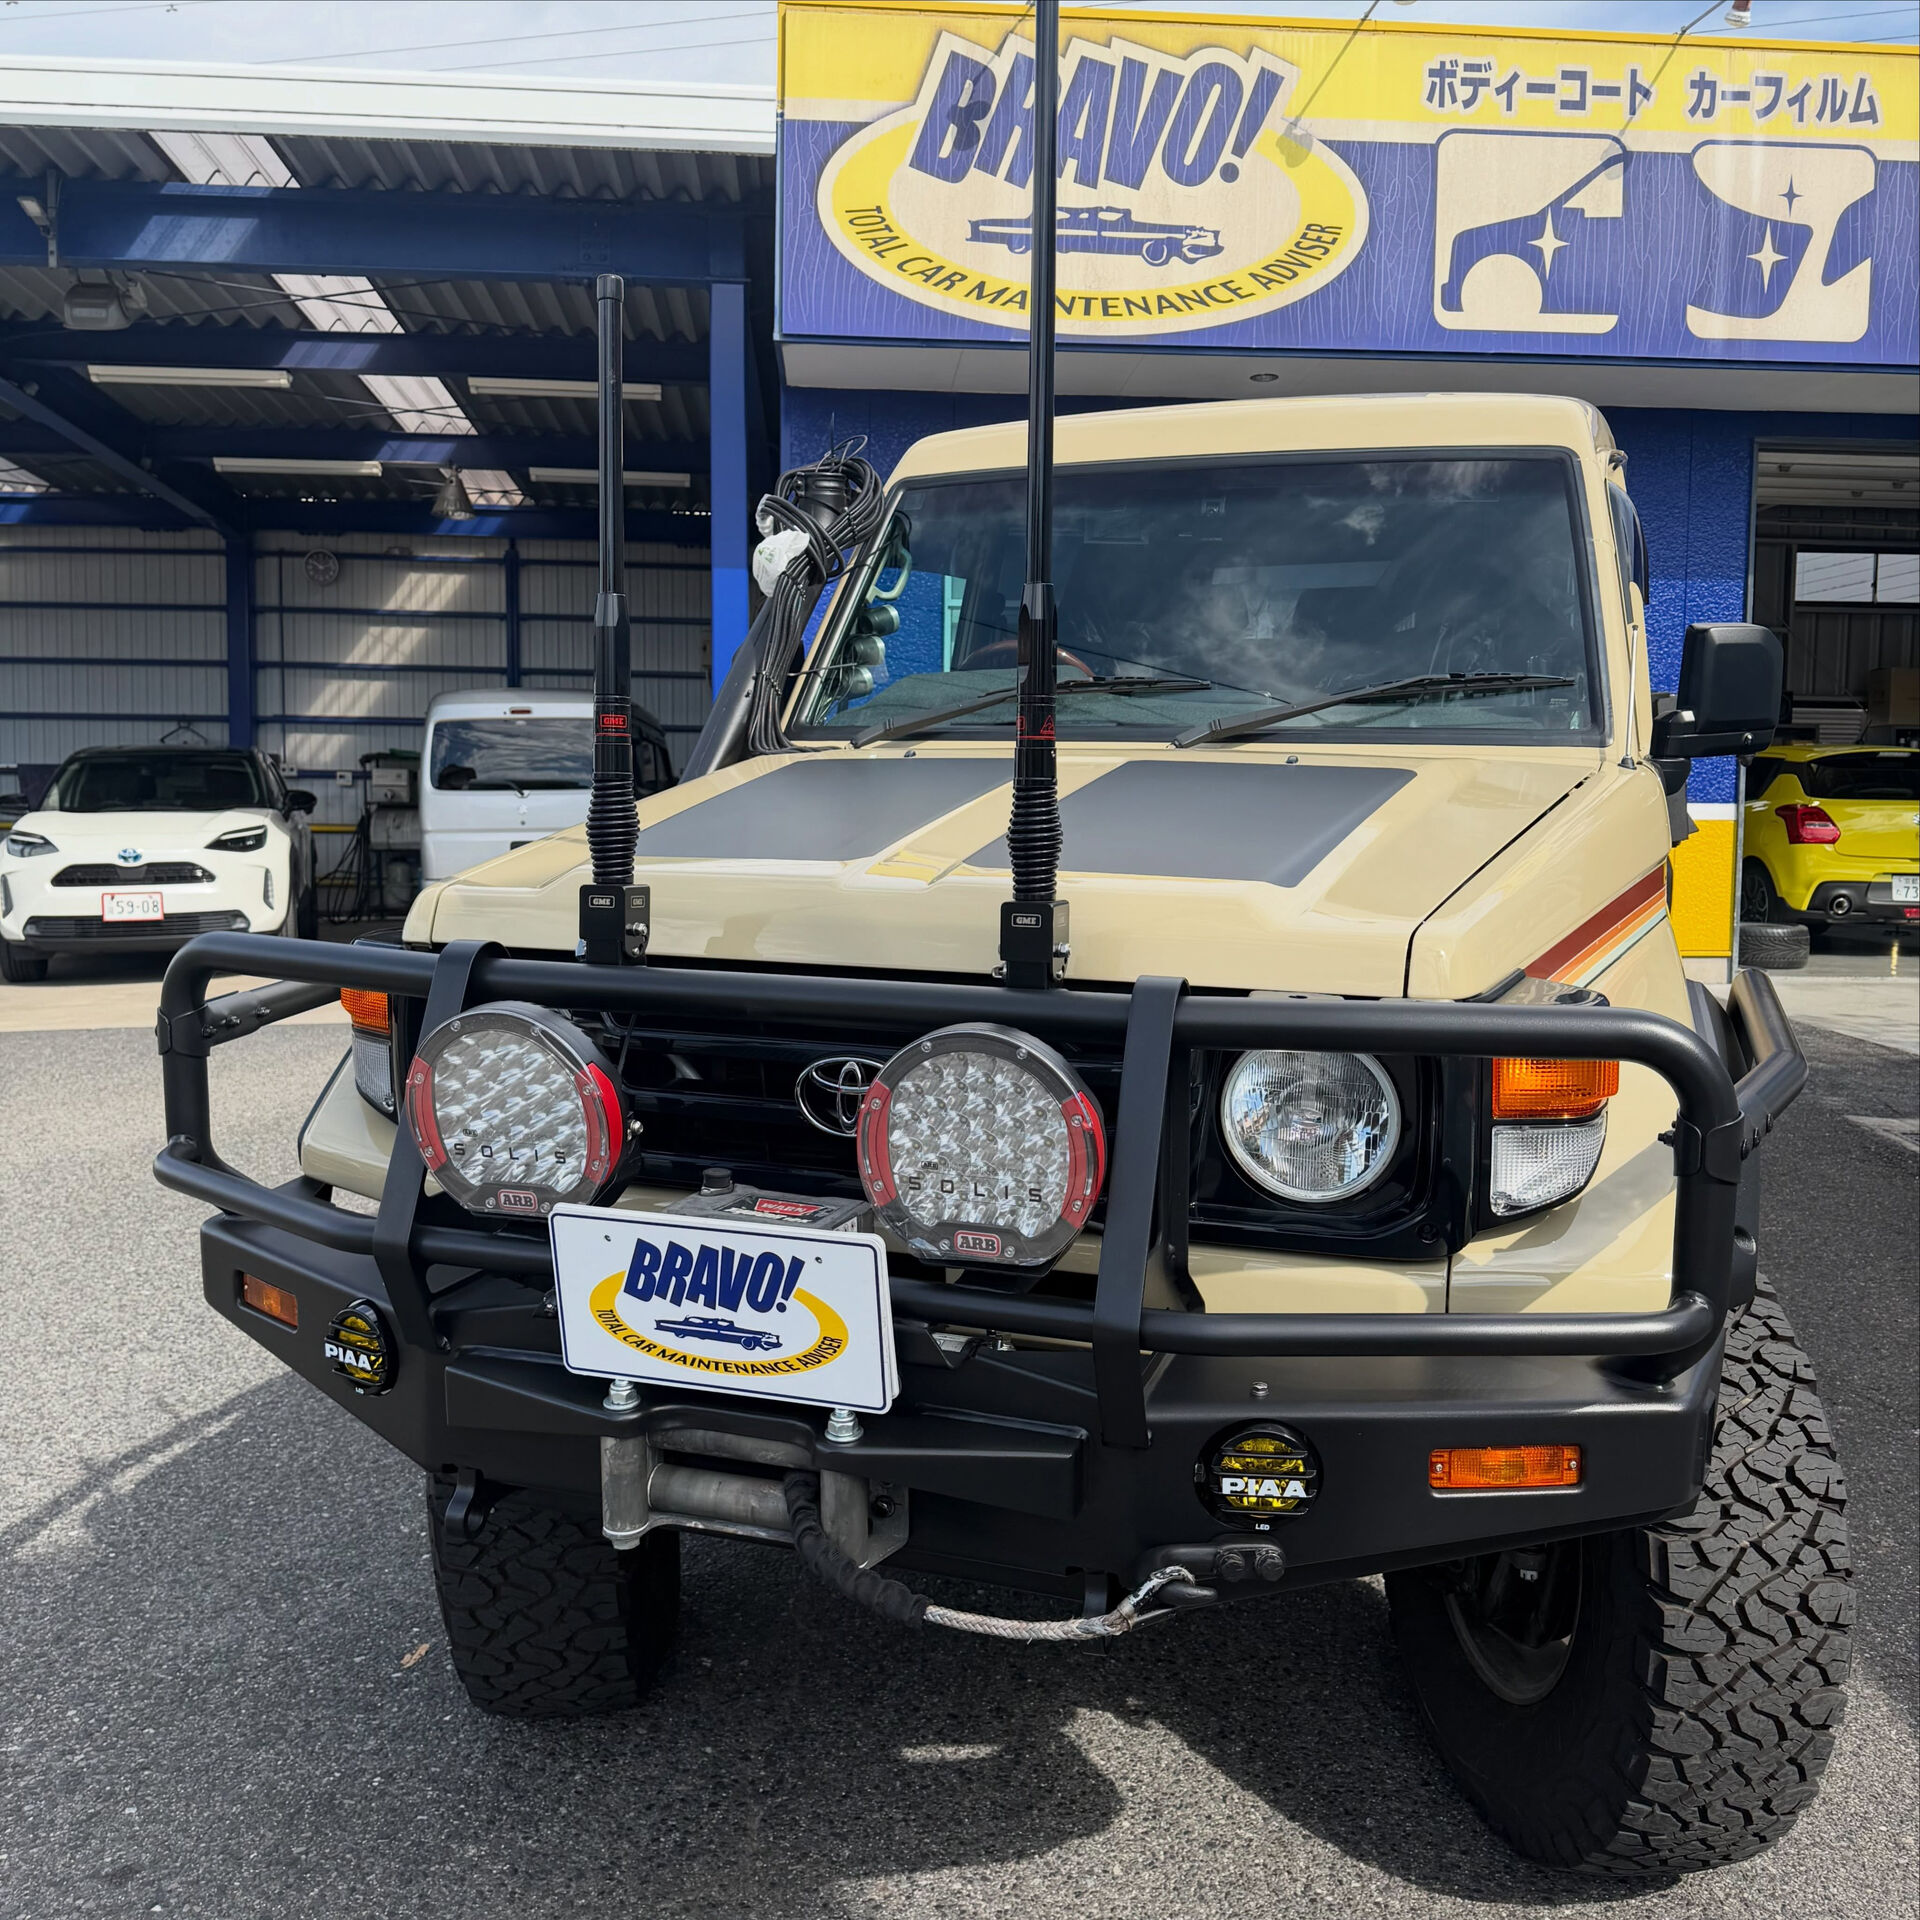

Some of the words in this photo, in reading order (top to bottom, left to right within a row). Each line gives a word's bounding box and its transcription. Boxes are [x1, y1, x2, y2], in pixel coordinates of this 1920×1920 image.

[1426, 59, 1653, 116] ボディーコート
[1688, 71, 1880, 125] カーフィルム
[909, 50, 1285, 191] BRAVO!
[845, 205, 909, 259] TOTAL
[896, 256, 968, 291] CAR
[964, 280, 1256, 317] MANTENANCE
[1247, 223, 1343, 290] ADVISER
[1016, 916, 1037, 925] GME
[454, 1143, 566, 1164] SOLIS
[502, 1193, 534, 1207] ARB
[909, 1176, 1042, 1203] SOLIS
[761, 1203, 806, 1213] WARN
[959, 1235, 997, 1251] ARB
[624, 1238, 805, 1313] BRAVO!
[596, 1309, 628, 1335] TOTAL
[622, 1334, 657, 1353] CAR
[656, 1348, 800, 1376] MAINTENANCE
[798, 1336, 843, 1368] ADVISER
[324, 1342, 372, 1371] PIAA
[1222, 1477, 1307, 1498] PIAA
[1255, 1523, 1270, 1531] LED
